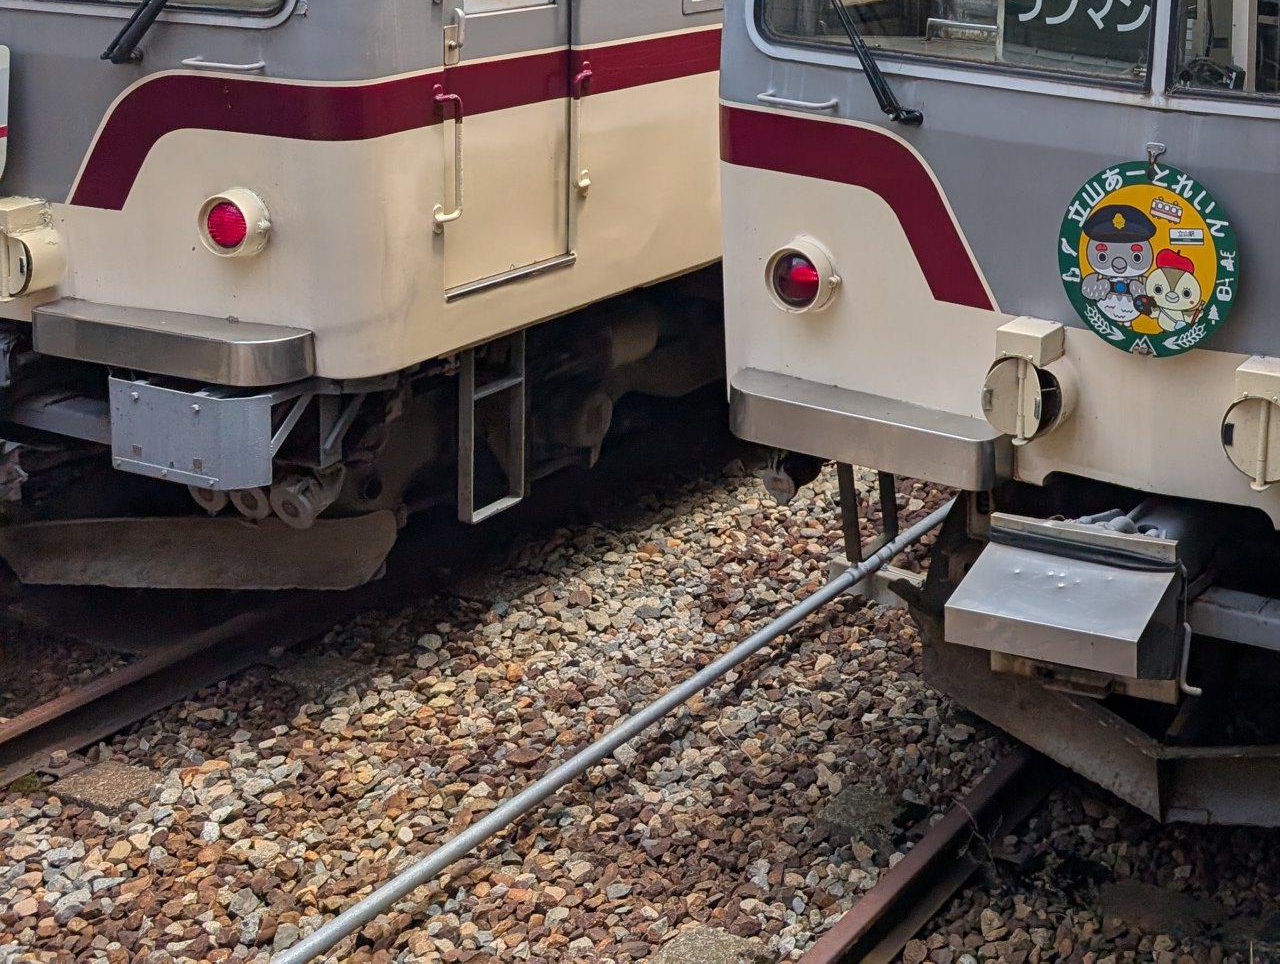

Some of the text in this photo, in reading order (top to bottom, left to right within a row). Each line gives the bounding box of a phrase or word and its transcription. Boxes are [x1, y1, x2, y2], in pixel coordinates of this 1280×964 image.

[1068, 164, 1229, 237] 立山あーとれいん
